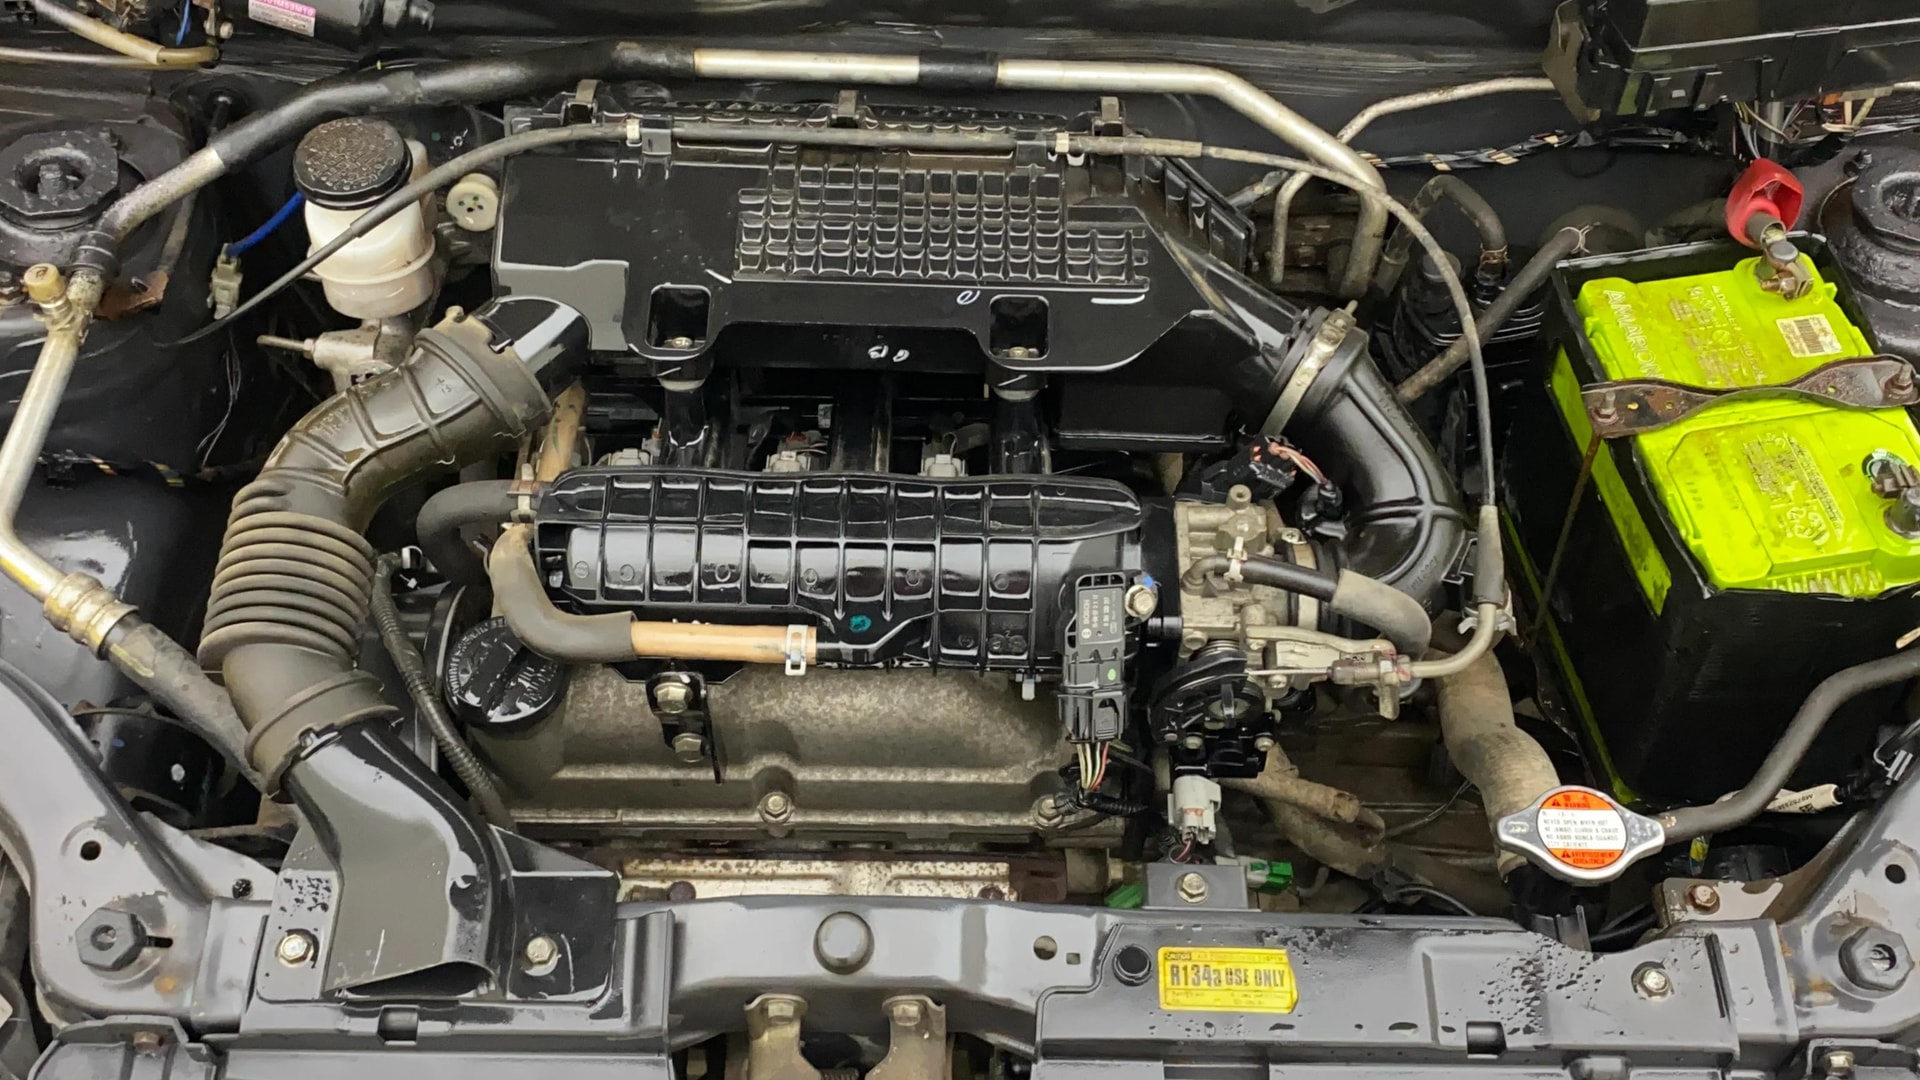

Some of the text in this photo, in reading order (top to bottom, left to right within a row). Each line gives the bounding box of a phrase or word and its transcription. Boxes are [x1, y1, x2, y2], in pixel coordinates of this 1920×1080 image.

[1602, 289, 1664, 379] AMARON
[1170, 963, 1285, 987] R134a USE ONLY
